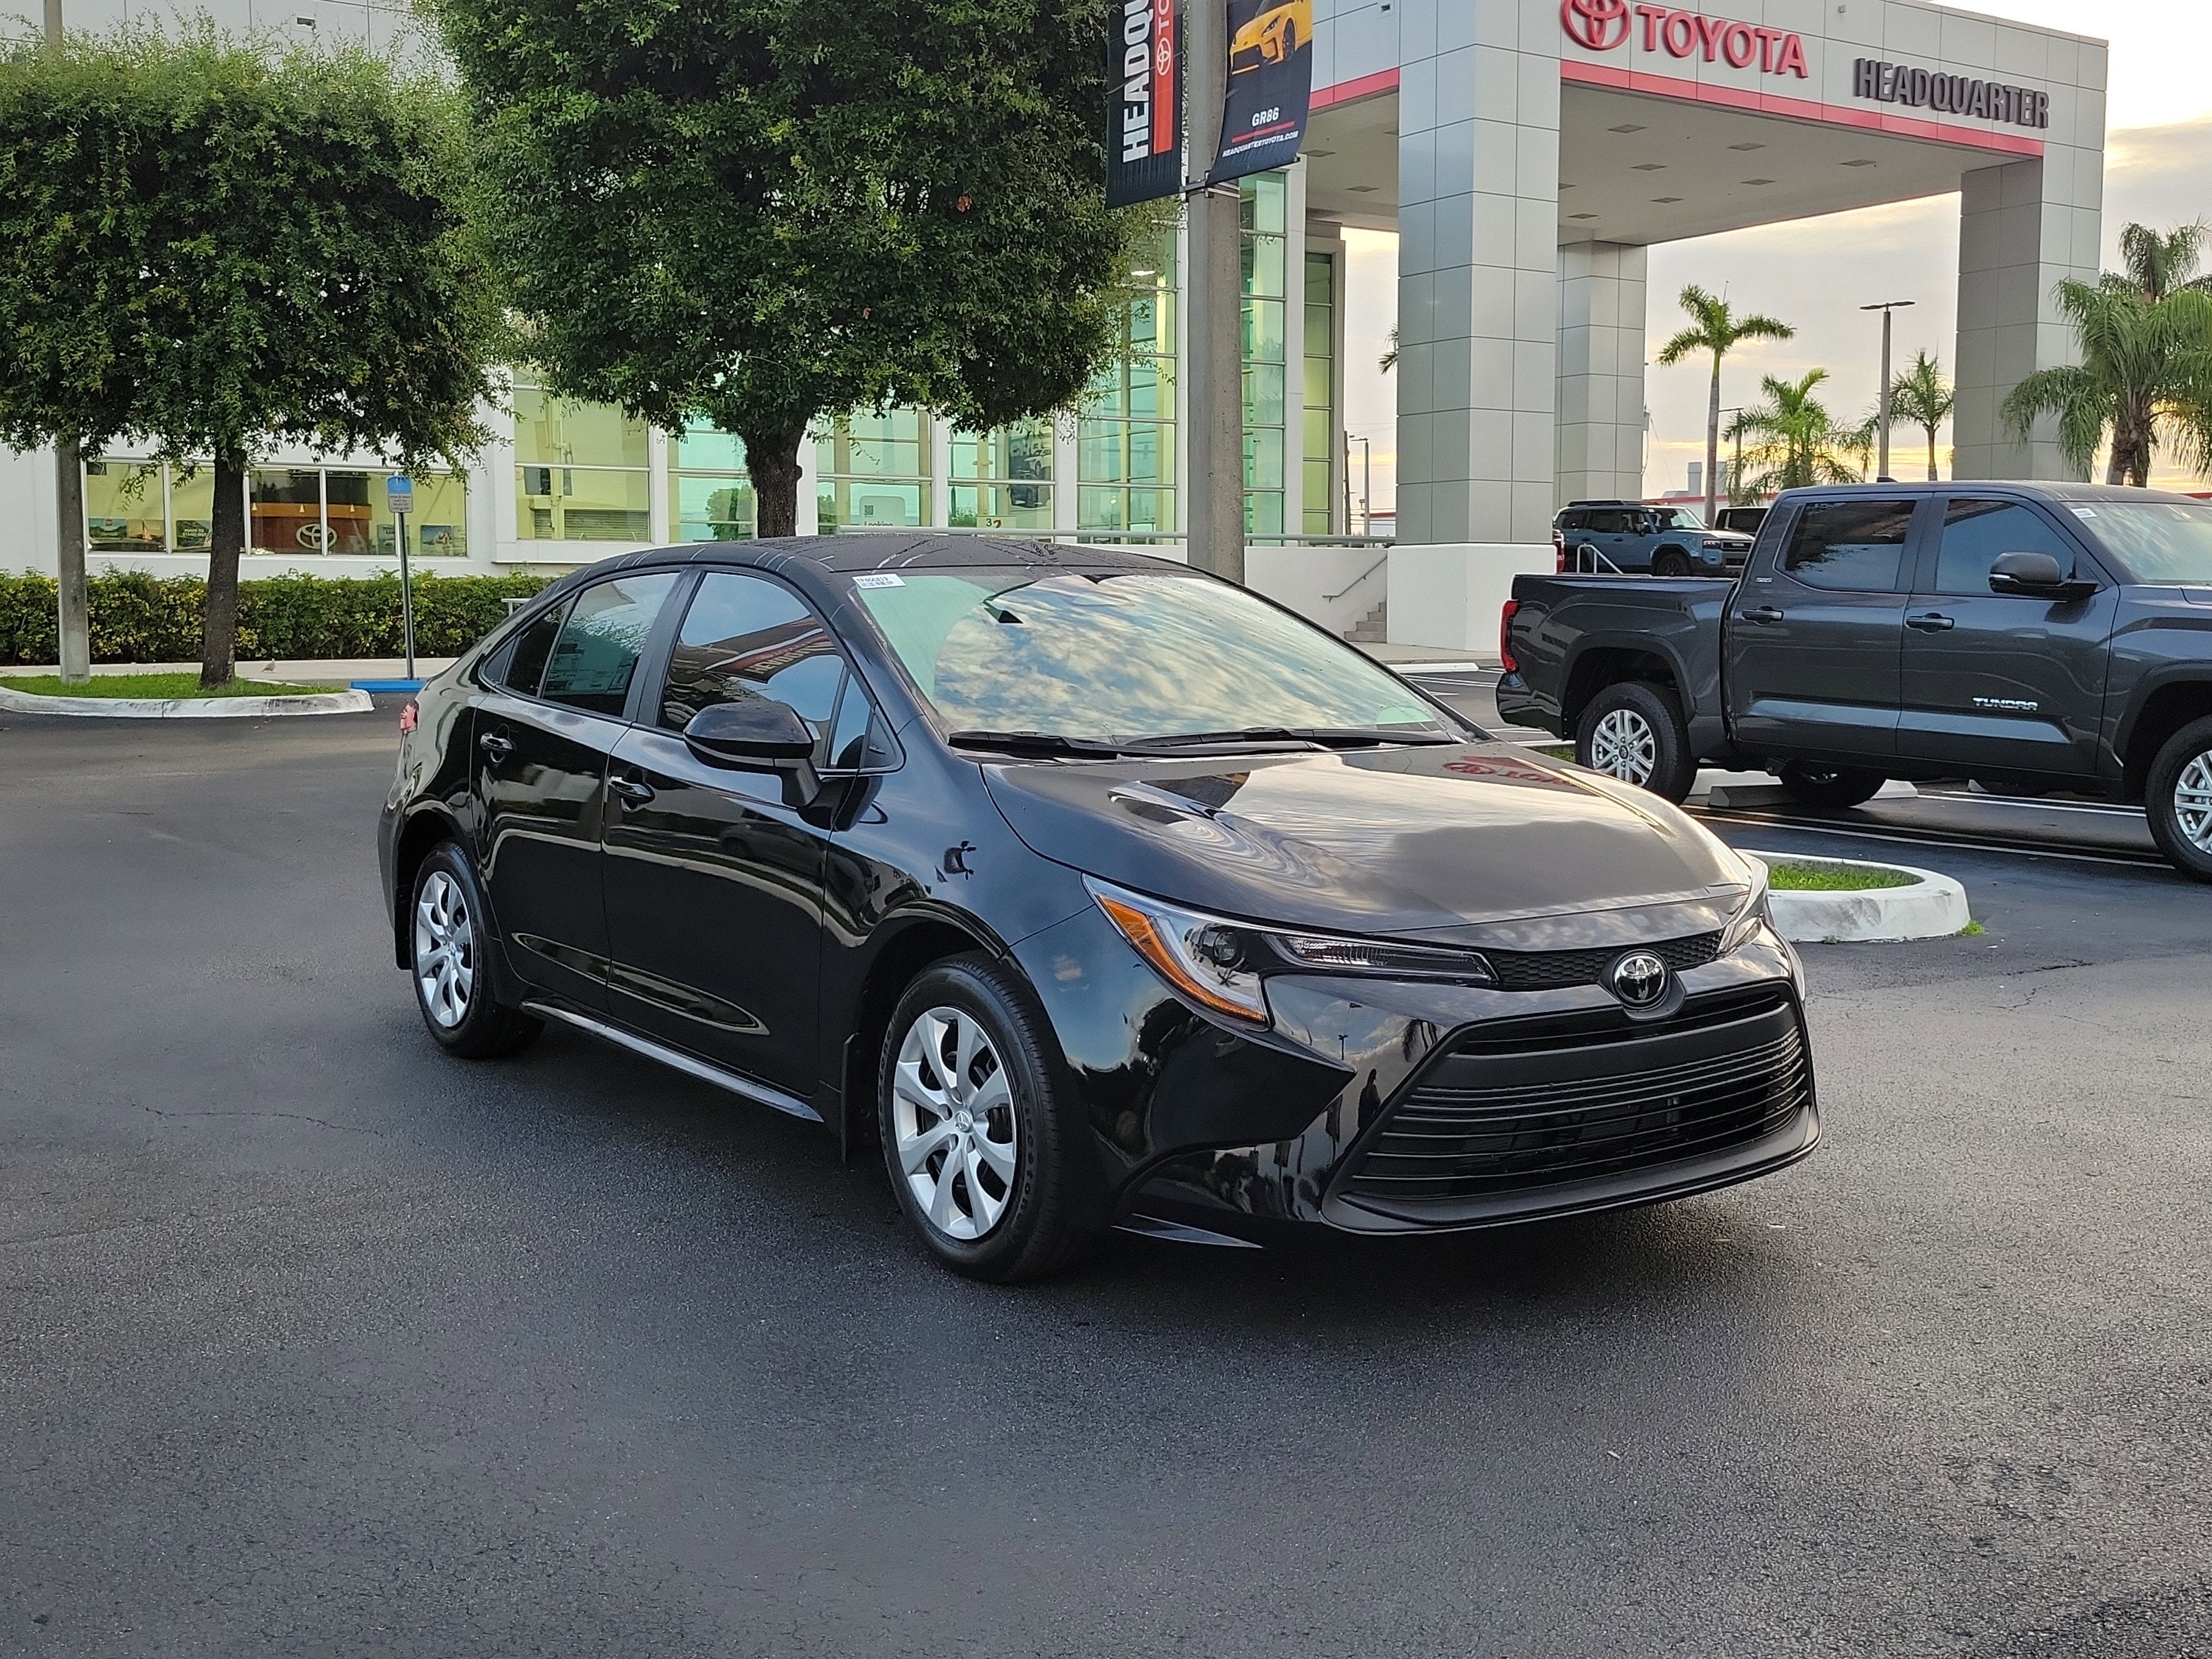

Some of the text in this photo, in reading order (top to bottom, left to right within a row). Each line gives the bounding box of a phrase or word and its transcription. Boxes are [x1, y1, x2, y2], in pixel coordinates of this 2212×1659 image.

[1636, 4, 1809, 79] TOYOTA
[1251, 106, 1279, 127] GR86
[1853, 58, 2049, 128] HEADQUARTER
[1222, 130, 1299, 158] HEADQUARTERTOYOTA.COM
